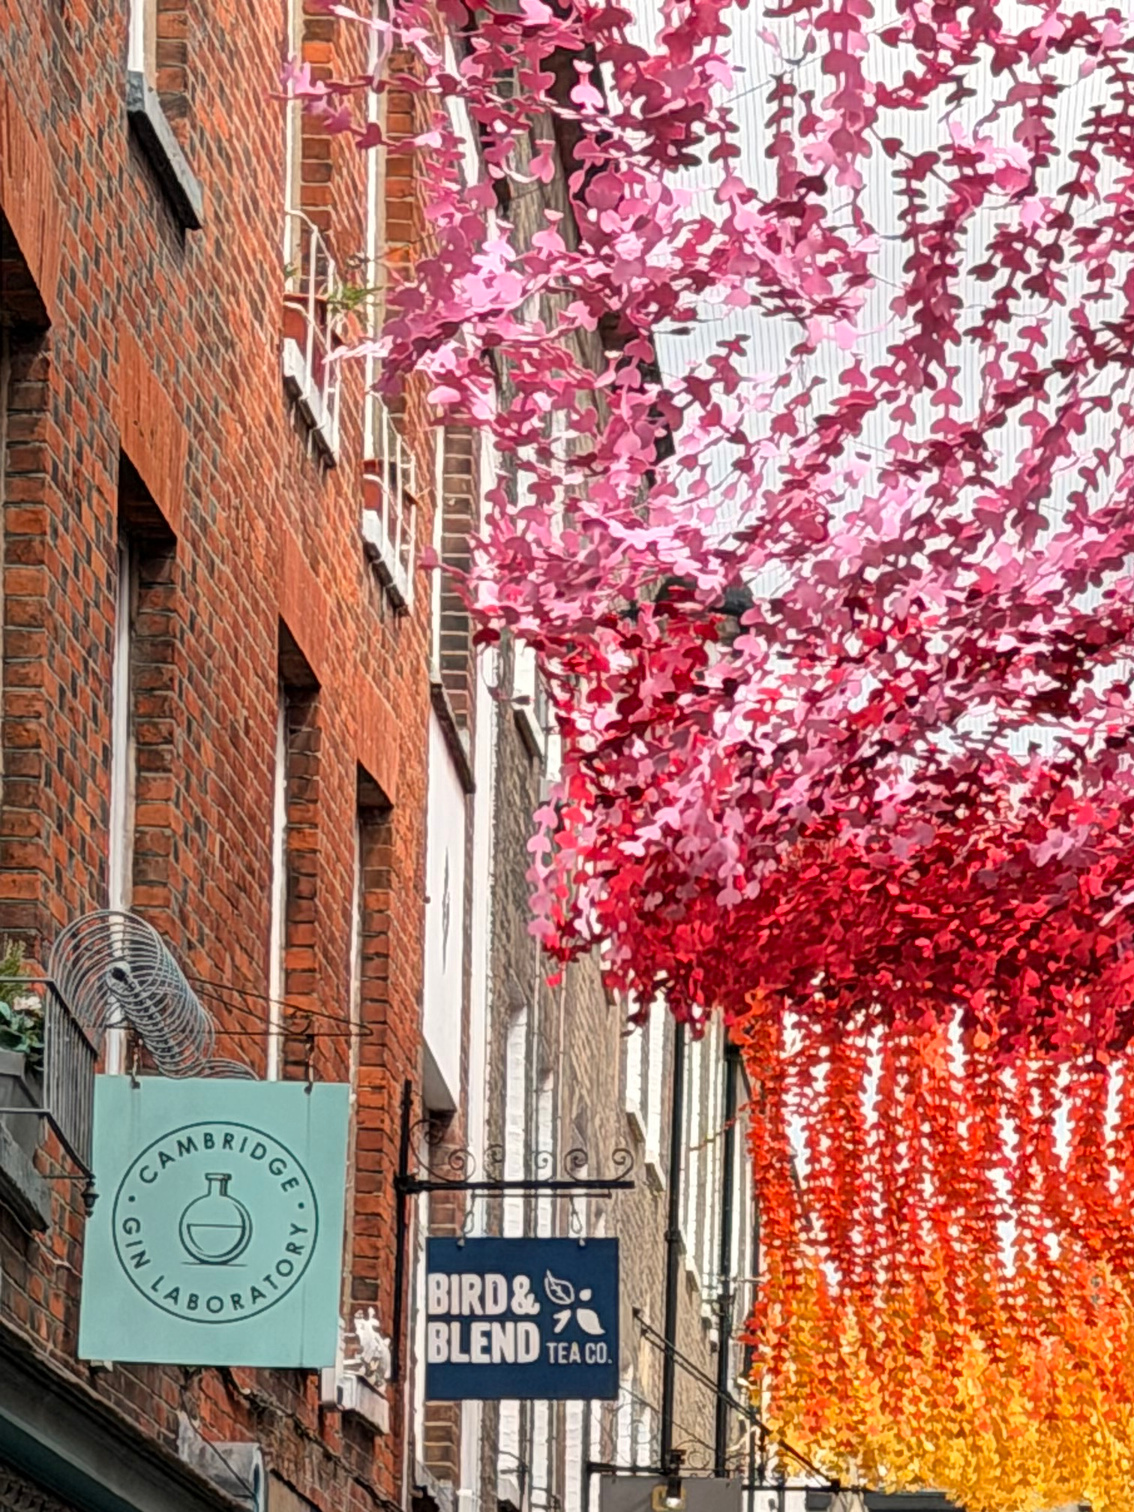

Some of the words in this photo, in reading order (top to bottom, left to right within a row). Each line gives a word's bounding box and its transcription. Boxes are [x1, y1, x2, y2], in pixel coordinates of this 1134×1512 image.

[138, 1132, 300, 1193] CAMBRIDGE
[122, 1217, 152, 1270] GIN
[150, 1222, 308, 1314] LABORATORY
[427, 1321, 541, 1364] BLEND
[546, 1341, 581, 1364] TEA
[585, 1341, 613, 1364] CO.
